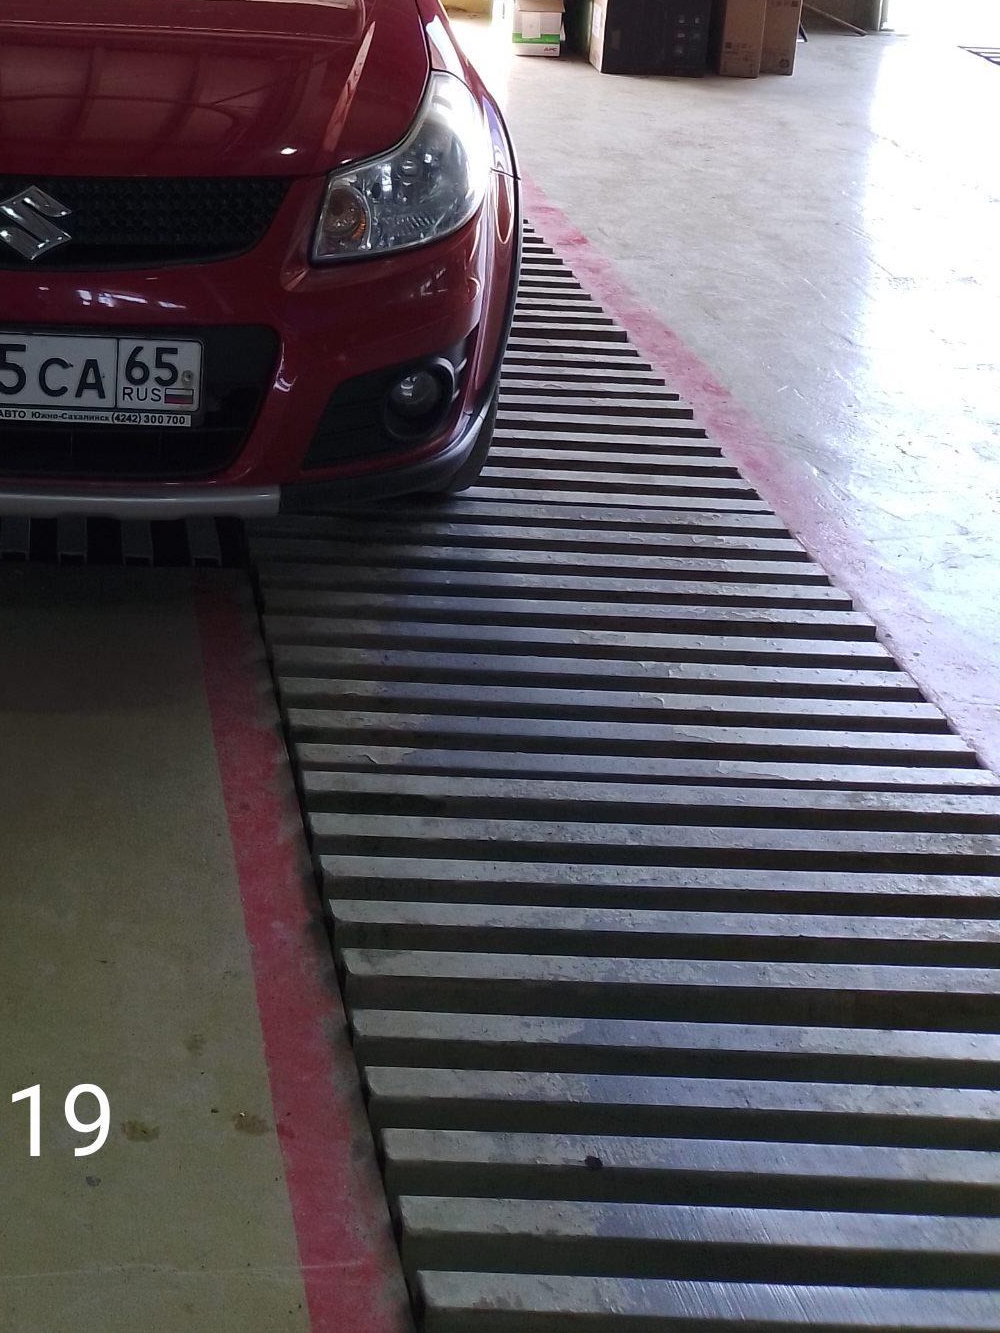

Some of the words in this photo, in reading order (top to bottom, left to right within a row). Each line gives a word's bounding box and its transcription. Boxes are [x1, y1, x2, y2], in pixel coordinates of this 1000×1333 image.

[124, 345, 179, 387] 65
[122, 386, 162, 403] RUS
[31, 411, 110, 422] Южно-Сахалинск
[111, 412, 142, 425] (4242)
[143, 414, 164, 424] 300
[166, 415, 186, 425] 700
